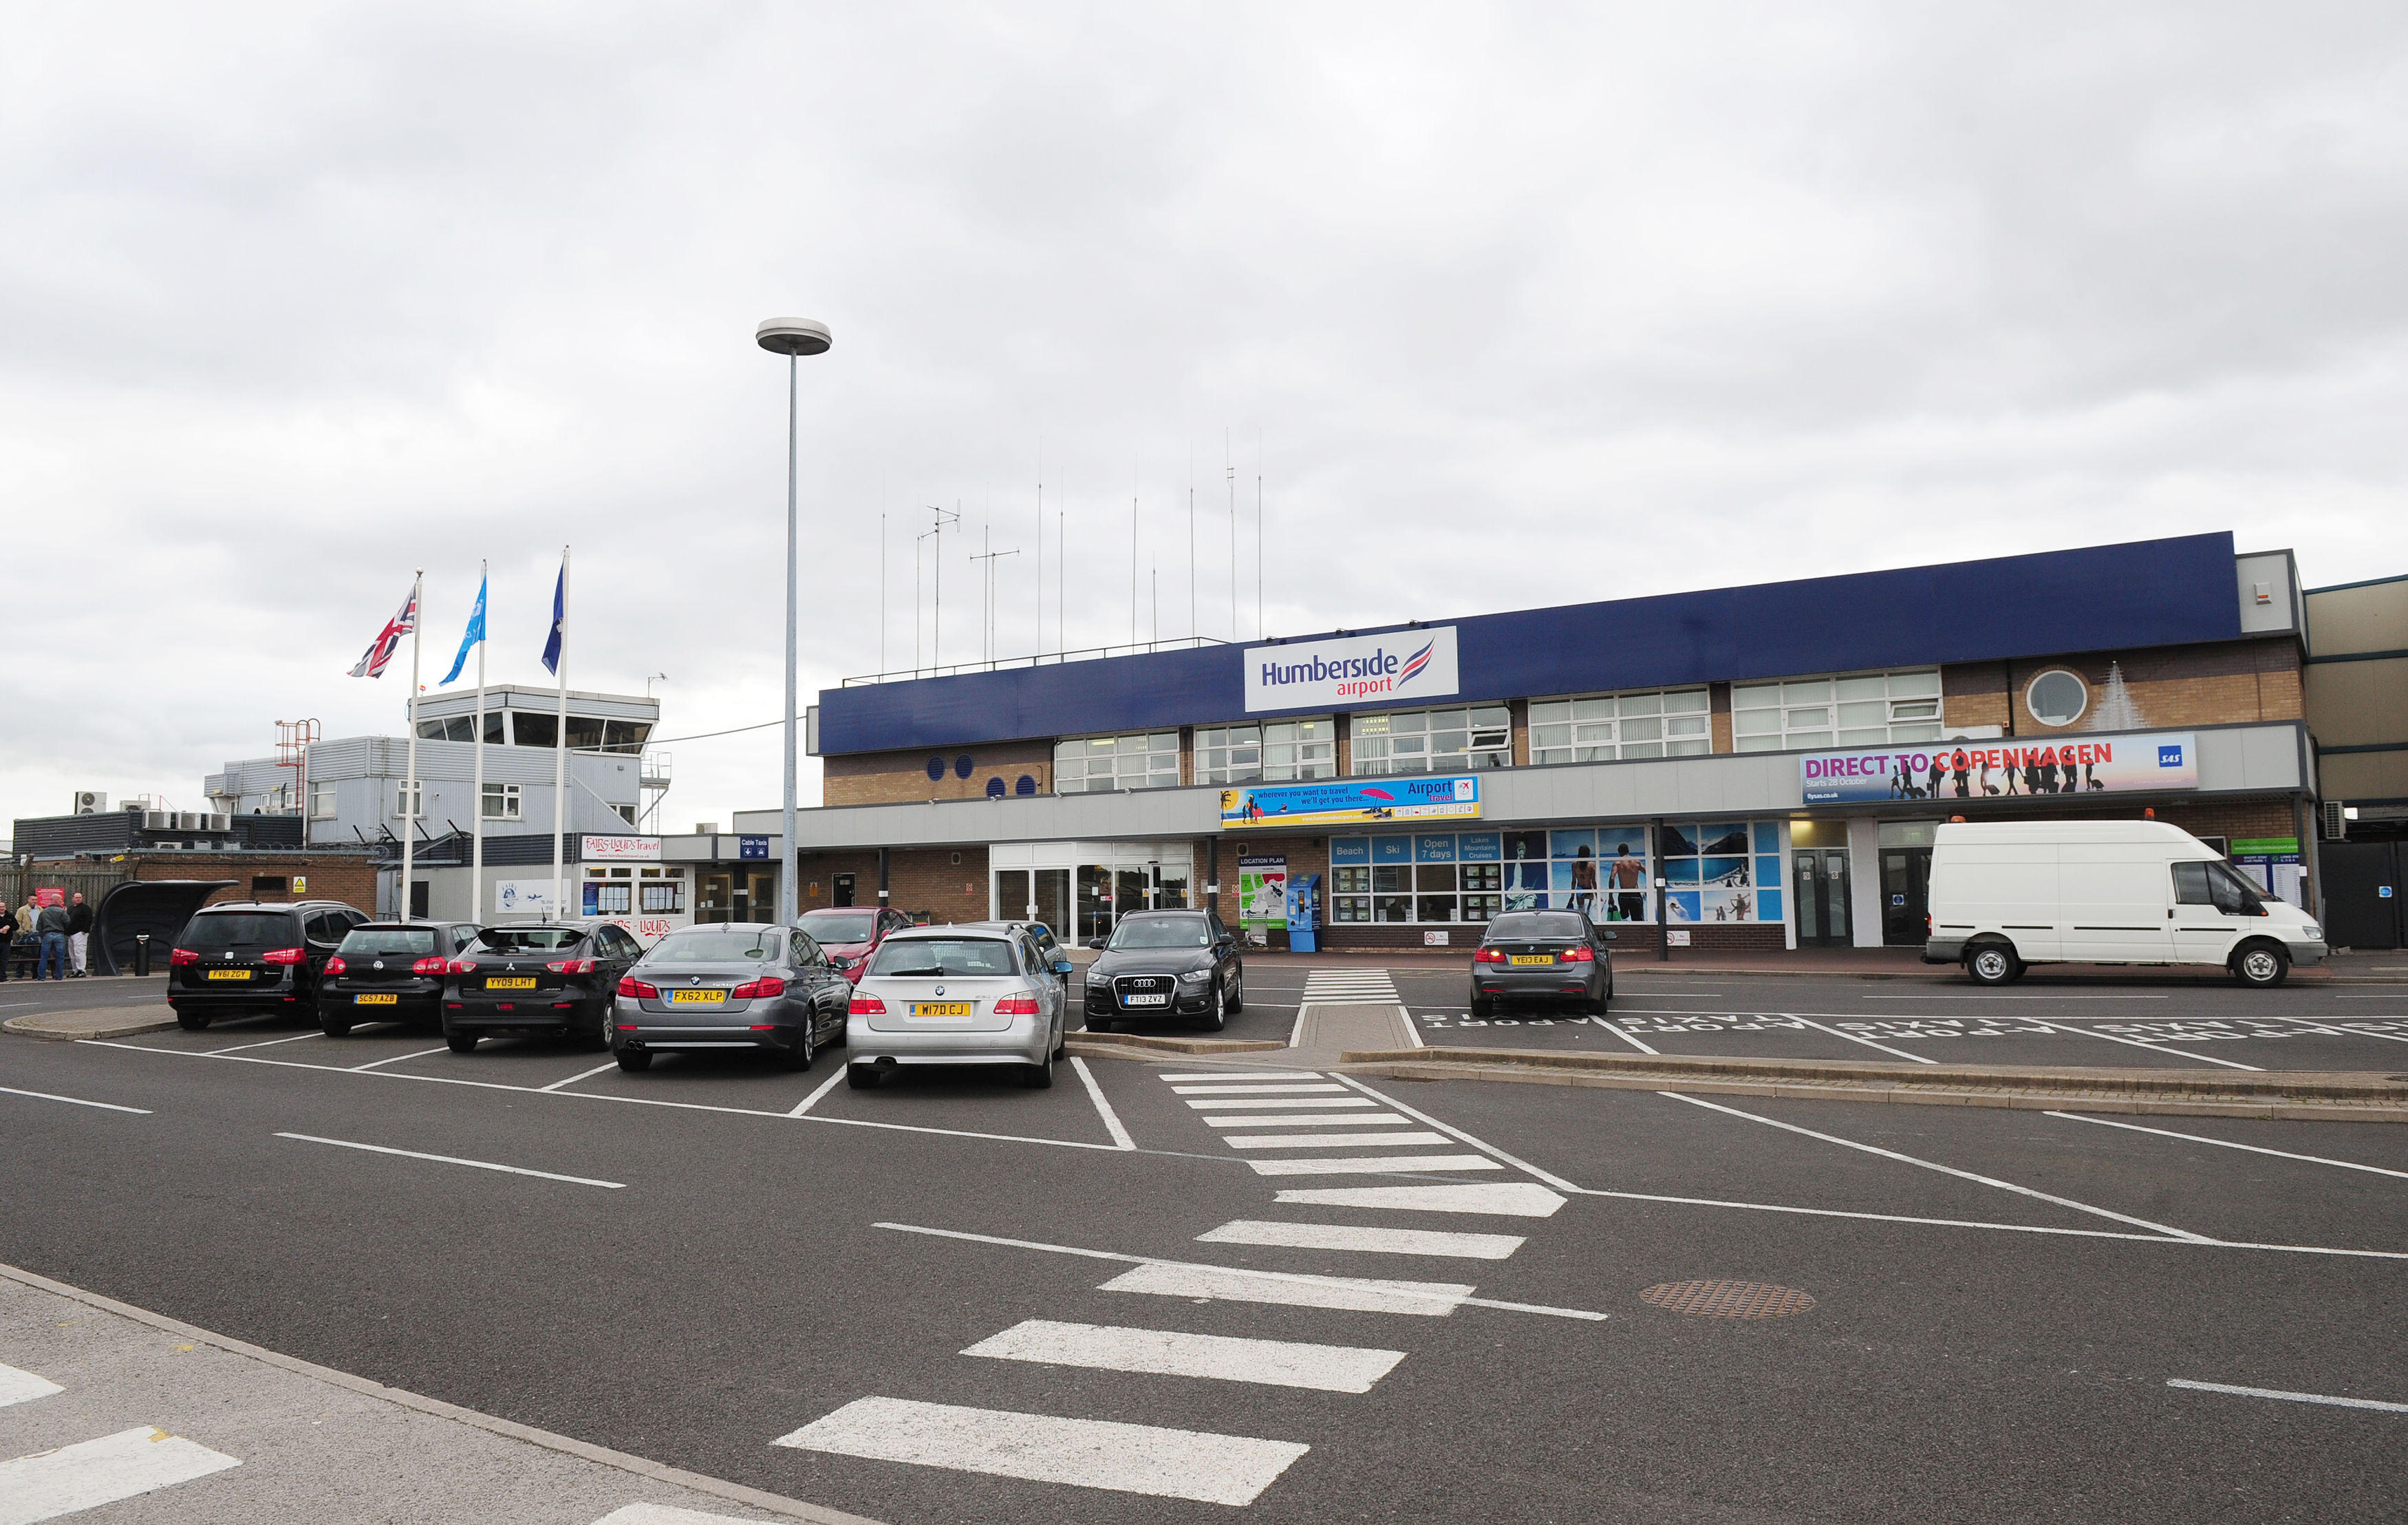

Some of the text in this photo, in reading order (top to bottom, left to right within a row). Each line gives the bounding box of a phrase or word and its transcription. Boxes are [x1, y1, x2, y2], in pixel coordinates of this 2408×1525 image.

[1262, 648, 1398, 686] Humberside
[1337, 676, 1393, 698] airport
[1805, 743, 2112, 778] DIRECT TO COPENHAGEN
[2160, 754, 2180, 763] SAS
[1806, 777, 1867, 788] Starts 28 October
[1408, 781, 1452, 797] Airport
[1319, 797, 1330, 805] get
[1430, 792, 1453, 801] travel
[636, 839, 659, 850] Travel
[1424, 839, 1448, 848] Open
[1337, 847, 1364, 855] Beach
[1386, 845, 1400, 854] Ski
[1430, 850, 1451, 859] days
[674, 992, 722, 1000] FX62 XLP
[1426, 1018, 1589, 1028] A-PORT
[1617, 1015, 1783, 1025] TAXIS
[1836, 1019, 2010, 1030] TAXIS
[1625, 1021, 1805, 1033] A-PORT
[2093, 1020, 2283, 1032] TAXIS
[1858, 1027, 2056, 1039] A-PORT
